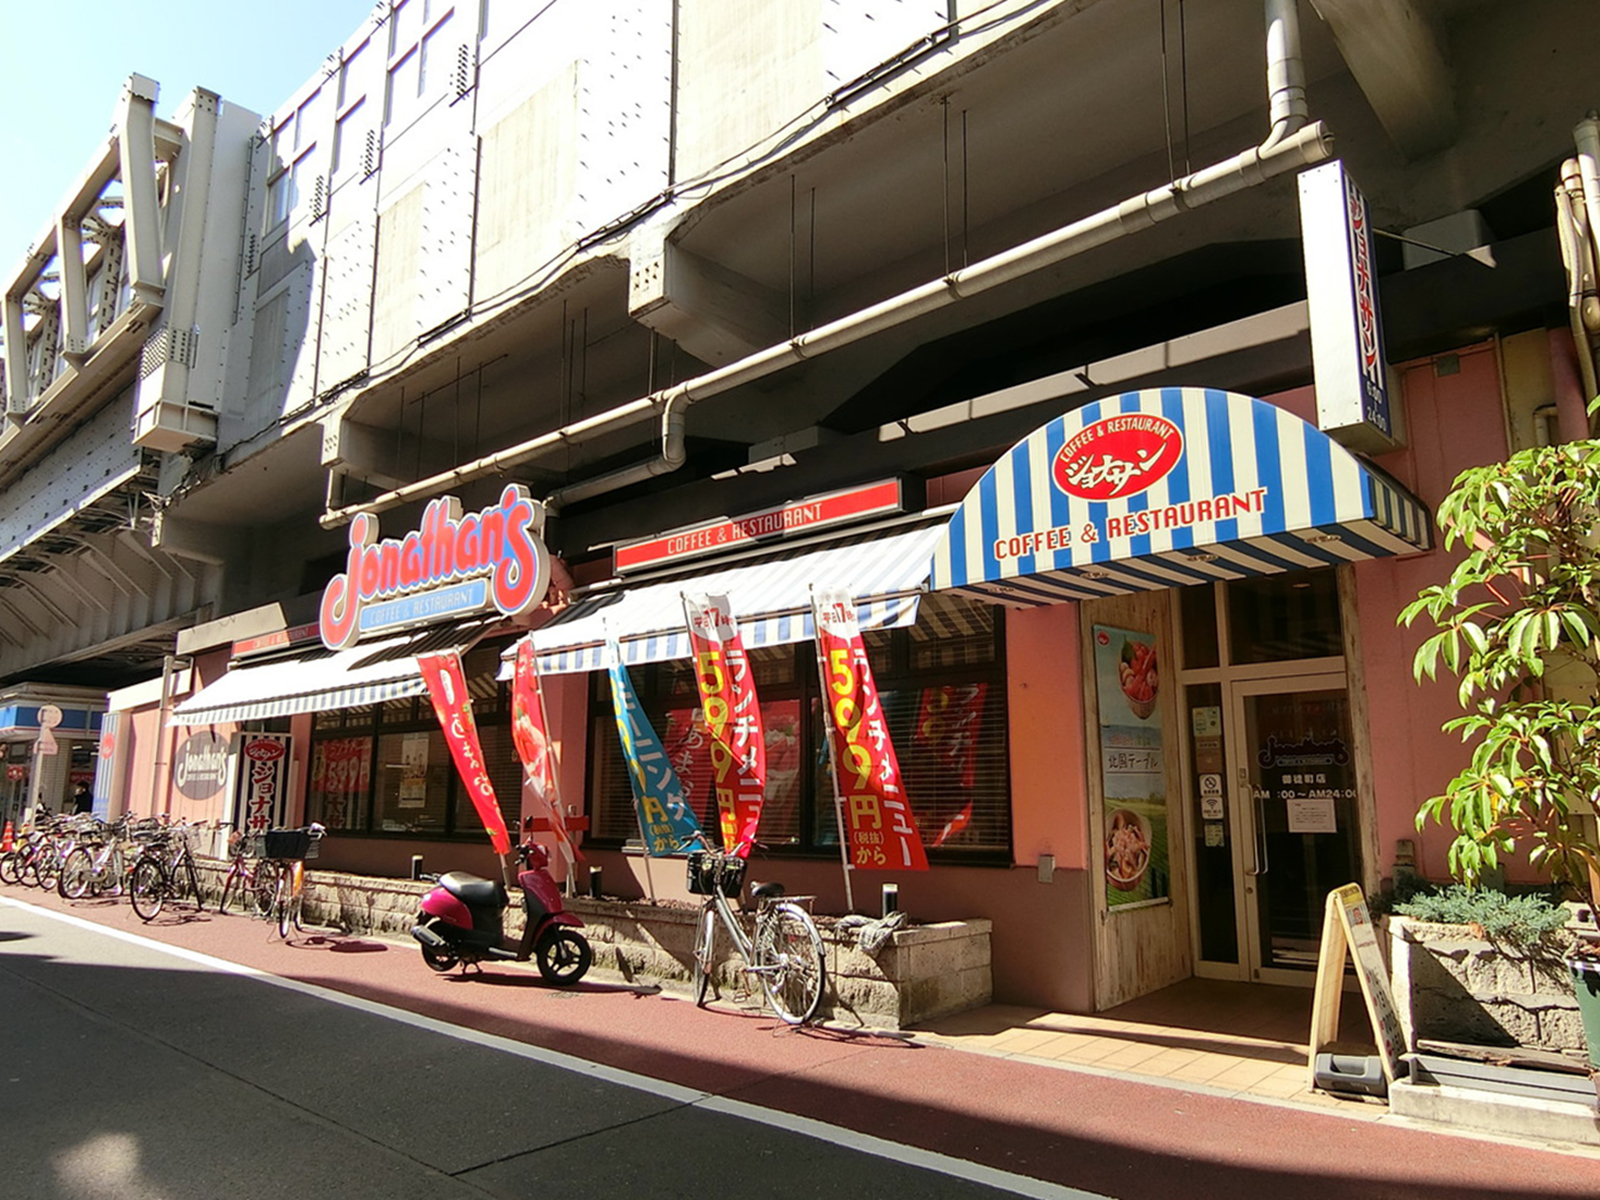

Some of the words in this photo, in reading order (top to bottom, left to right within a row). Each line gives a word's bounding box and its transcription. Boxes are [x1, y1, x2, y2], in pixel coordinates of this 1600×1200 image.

[1060, 431, 1094, 463] COFFEE
[1096, 425, 1105, 438] &
[1107, 417, 1175, 440] RESTAURANT
[1064, 441, 1168, 496] ジョナサン
[667, 530, 712, 555] COFFEE
[717, 526, 727, 543] &
[732, 502, 823, 540] RESTAURANT
[994, 526, 1071, 561] COFFEE
[1080, 523, 1098, 544] &
[1107, 488, 1266, 539] RESTAURANT
[370, 604, 401, 625] COFFEE
[413, 587, 474, 614] RESTAURANT
[853, 648, 913, 867] ランチメニュー
[1108, 752, 1159, 769] 北国テーブル
[653, 836, 680, 853] から
[855, 847, 886, 865] から
